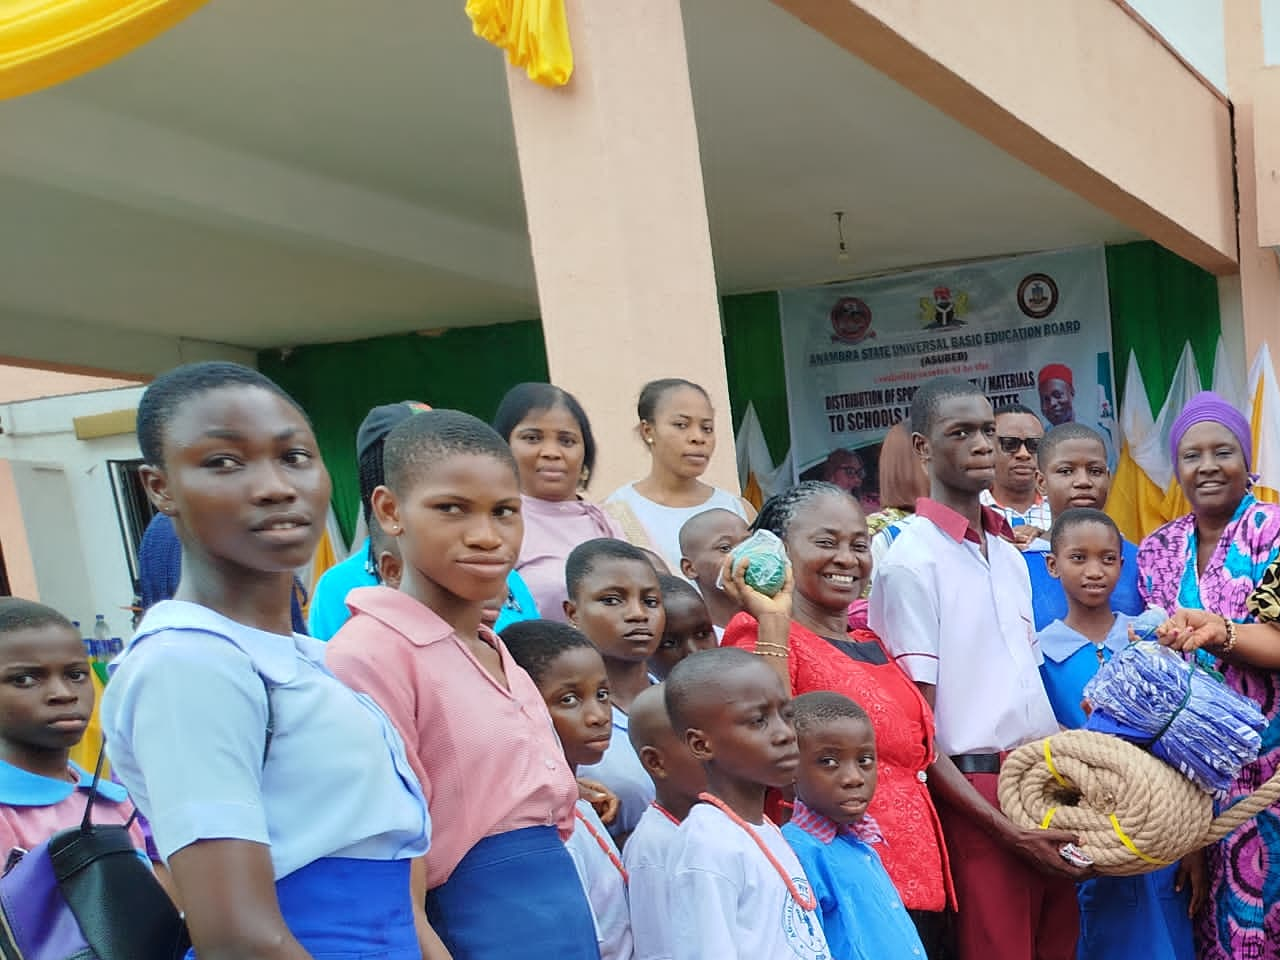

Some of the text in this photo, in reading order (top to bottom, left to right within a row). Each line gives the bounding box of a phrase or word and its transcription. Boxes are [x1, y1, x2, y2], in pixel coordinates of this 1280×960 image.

[809, 320, 1081, 367] ANAMBRA STATE UNIVERSAL BASIC EDUCATION BOARD
[825, 389, 884, 411] DISTRIBUTION
[884, 387, 895, 403] OF
[989, 371, 1035, 391] MATERIALS
[828, 413, 845, 432] TO
[847, 407, 903, 431] SCHOOLS
